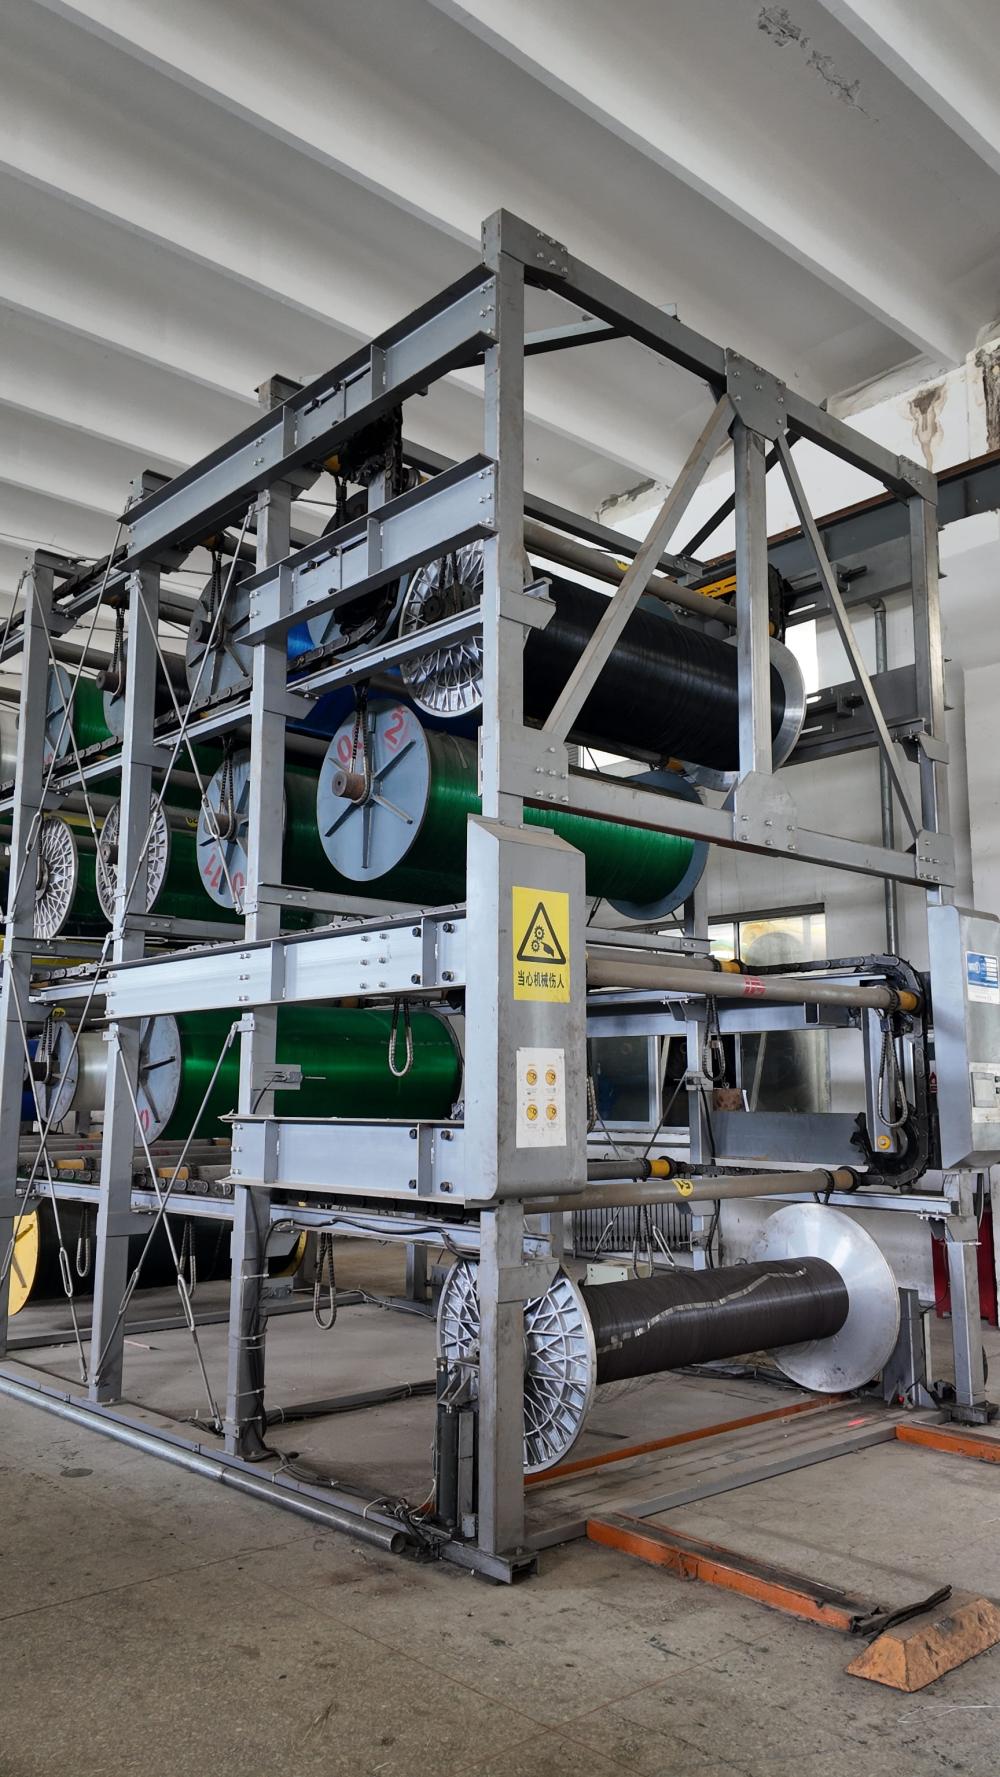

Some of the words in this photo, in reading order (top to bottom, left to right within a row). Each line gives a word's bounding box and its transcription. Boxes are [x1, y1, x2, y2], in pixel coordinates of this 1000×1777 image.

[517, 969, 565, 989] 当心机械伤人
